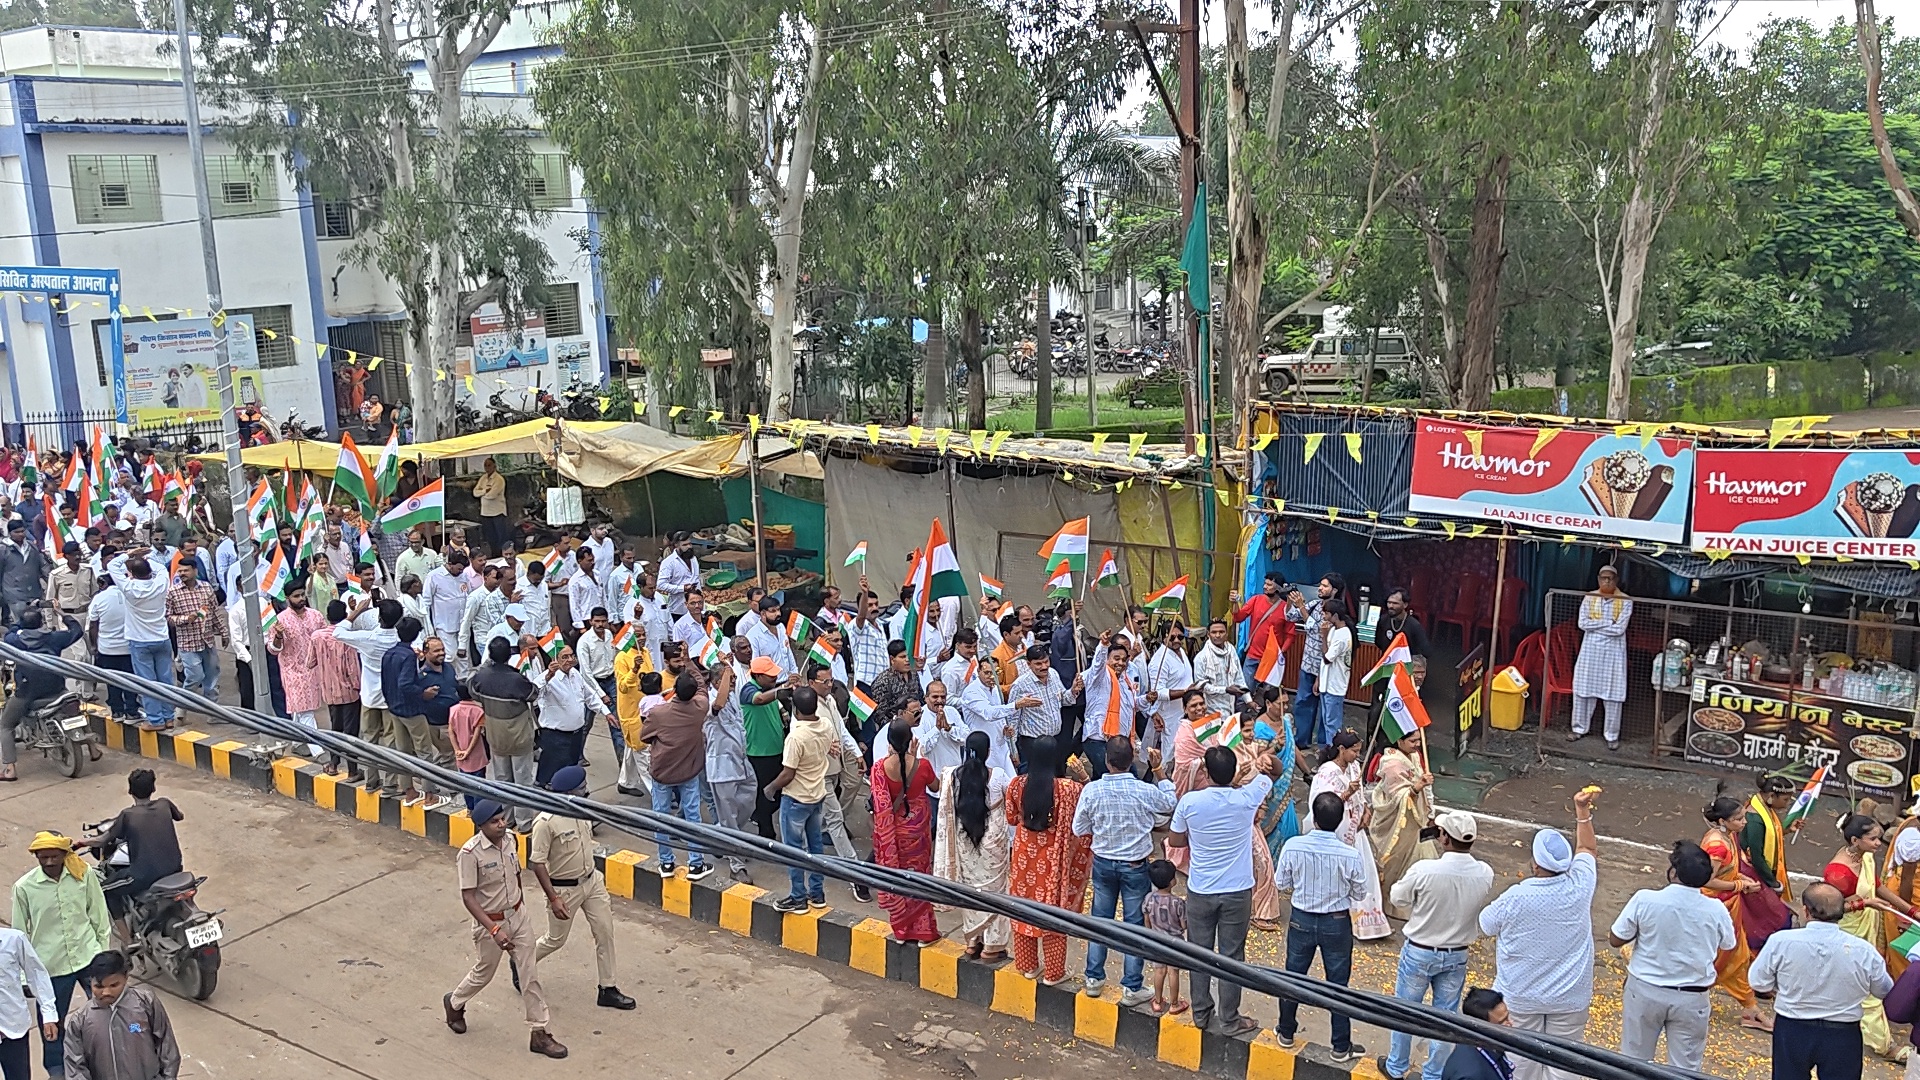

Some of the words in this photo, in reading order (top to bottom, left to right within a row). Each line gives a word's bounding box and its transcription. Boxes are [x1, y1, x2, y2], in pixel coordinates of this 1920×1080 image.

[0, 270, 28, 289] सिविल
[31, 274, 71, 291] अस्पताल
[73, 276, 107, 292] आमला
[1433, 426, 1456, 434] LOTTE
[1437, 441, 1551, 478] Havmor
[1486, 474, 1508, 482] CREAM
[1703, 472, 1807, 497] Havmor
[1728, 496, 1744, 504] ICE
[1746, 496, 1779, 505] CREAM
[1483, 507, 1529, 522] LALAJI
[1531, 513, 1553, 524] ICE
[1555, 516, 1602, 530] CREAM
[1704, 537, 1764, 551] ZIYAN
[1767, 539, 1828, 555] JUICE
[1832, 541, 1916, 557] CENTER
[1459, 685, 1482, 732] चाय
[1841, 709, 1906, 735] बेस्ट
[192, 929, 218, 945] 6799
